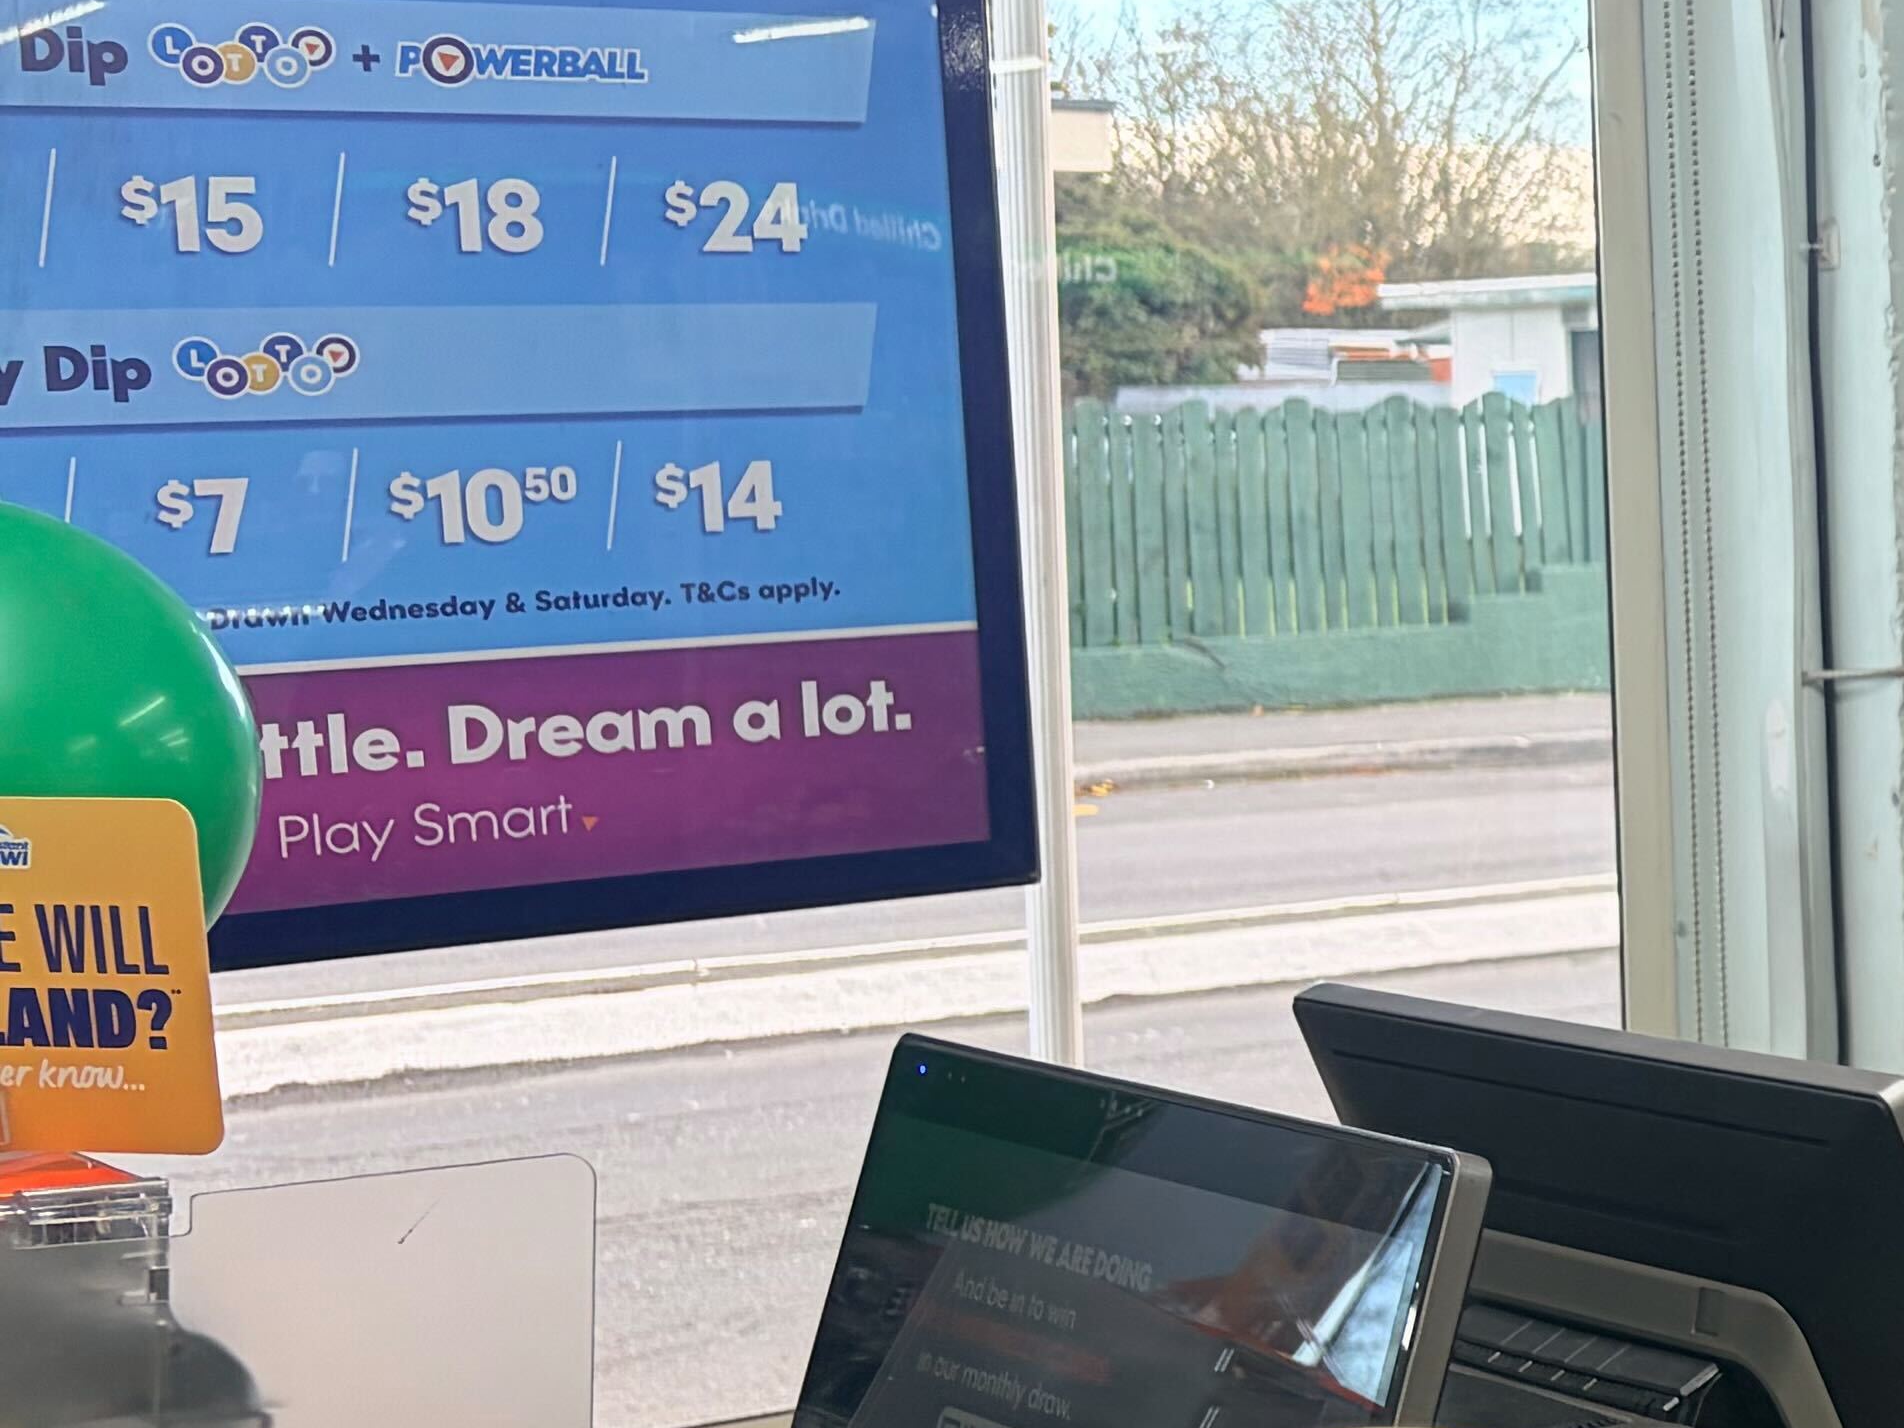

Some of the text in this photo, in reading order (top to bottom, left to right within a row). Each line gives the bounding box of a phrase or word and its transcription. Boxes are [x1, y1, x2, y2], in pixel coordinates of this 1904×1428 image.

[20, 27, 129, 87] Dip
[396, 34, 648, 87] POWERBALL
[120, 175, 808, 254] $15 $18 $24
[44, 345, 153, 403] Dip
[156, 477, 249, 555] $7
[655, 460, 783, 534] $14
[209, 576, 841, 631] Drawn Wednesday & Saturday. T&Cs apply.
[260, 678, 913, 780] ttle. Dream a lot.
[279, 795, 572, 862] Play Smart
[34, 904, 169, 974] WILL
[40, 1058, 145, 1091] know...
[926, 1203, 1153, 1293] TELL US HOW WE ARE DOING
[961, 1365, 1027, 1410] monthly
